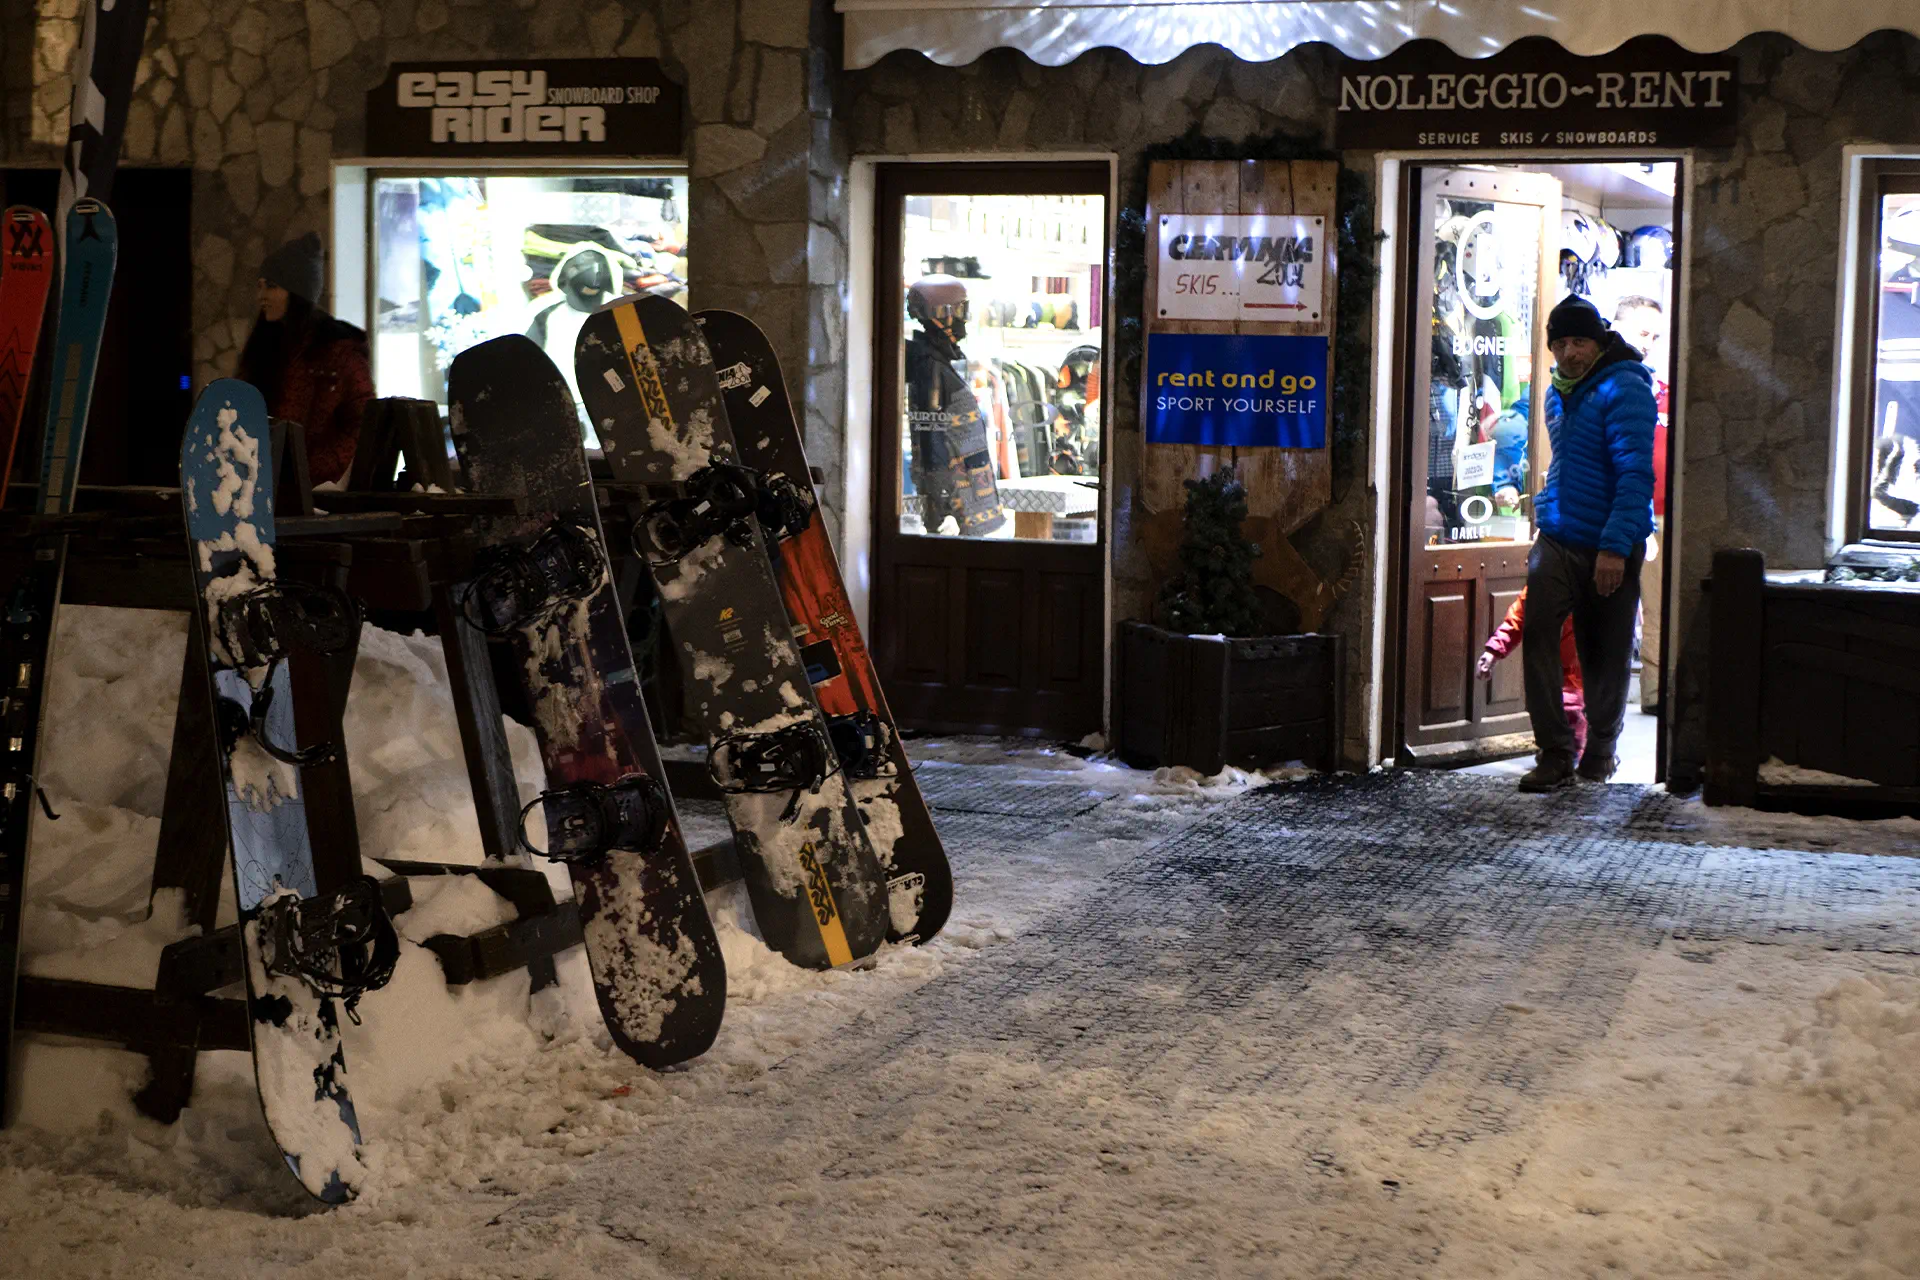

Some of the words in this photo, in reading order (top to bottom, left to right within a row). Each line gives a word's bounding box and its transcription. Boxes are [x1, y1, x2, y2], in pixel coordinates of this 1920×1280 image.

[547, 87, 624, 104] SNOWBOARD
[626, 87, 660, 103] SHOP
[1418, 132, 1480, 145] SERVICE
[1500, 132, 1534, 145] SKIS
[1556, 131, 1657, 144] SNOWBOARDS
[1157, 370, 1215, 388] rent
[1221, 369, 1275, 389] and
[1281, 375, 1316, 395] go
[1156, 397, 1215, 412] SPORT
[1222, 398, 1317, 414] YOURSELF
[1451, 525, 1492, 540] OAKLEY
